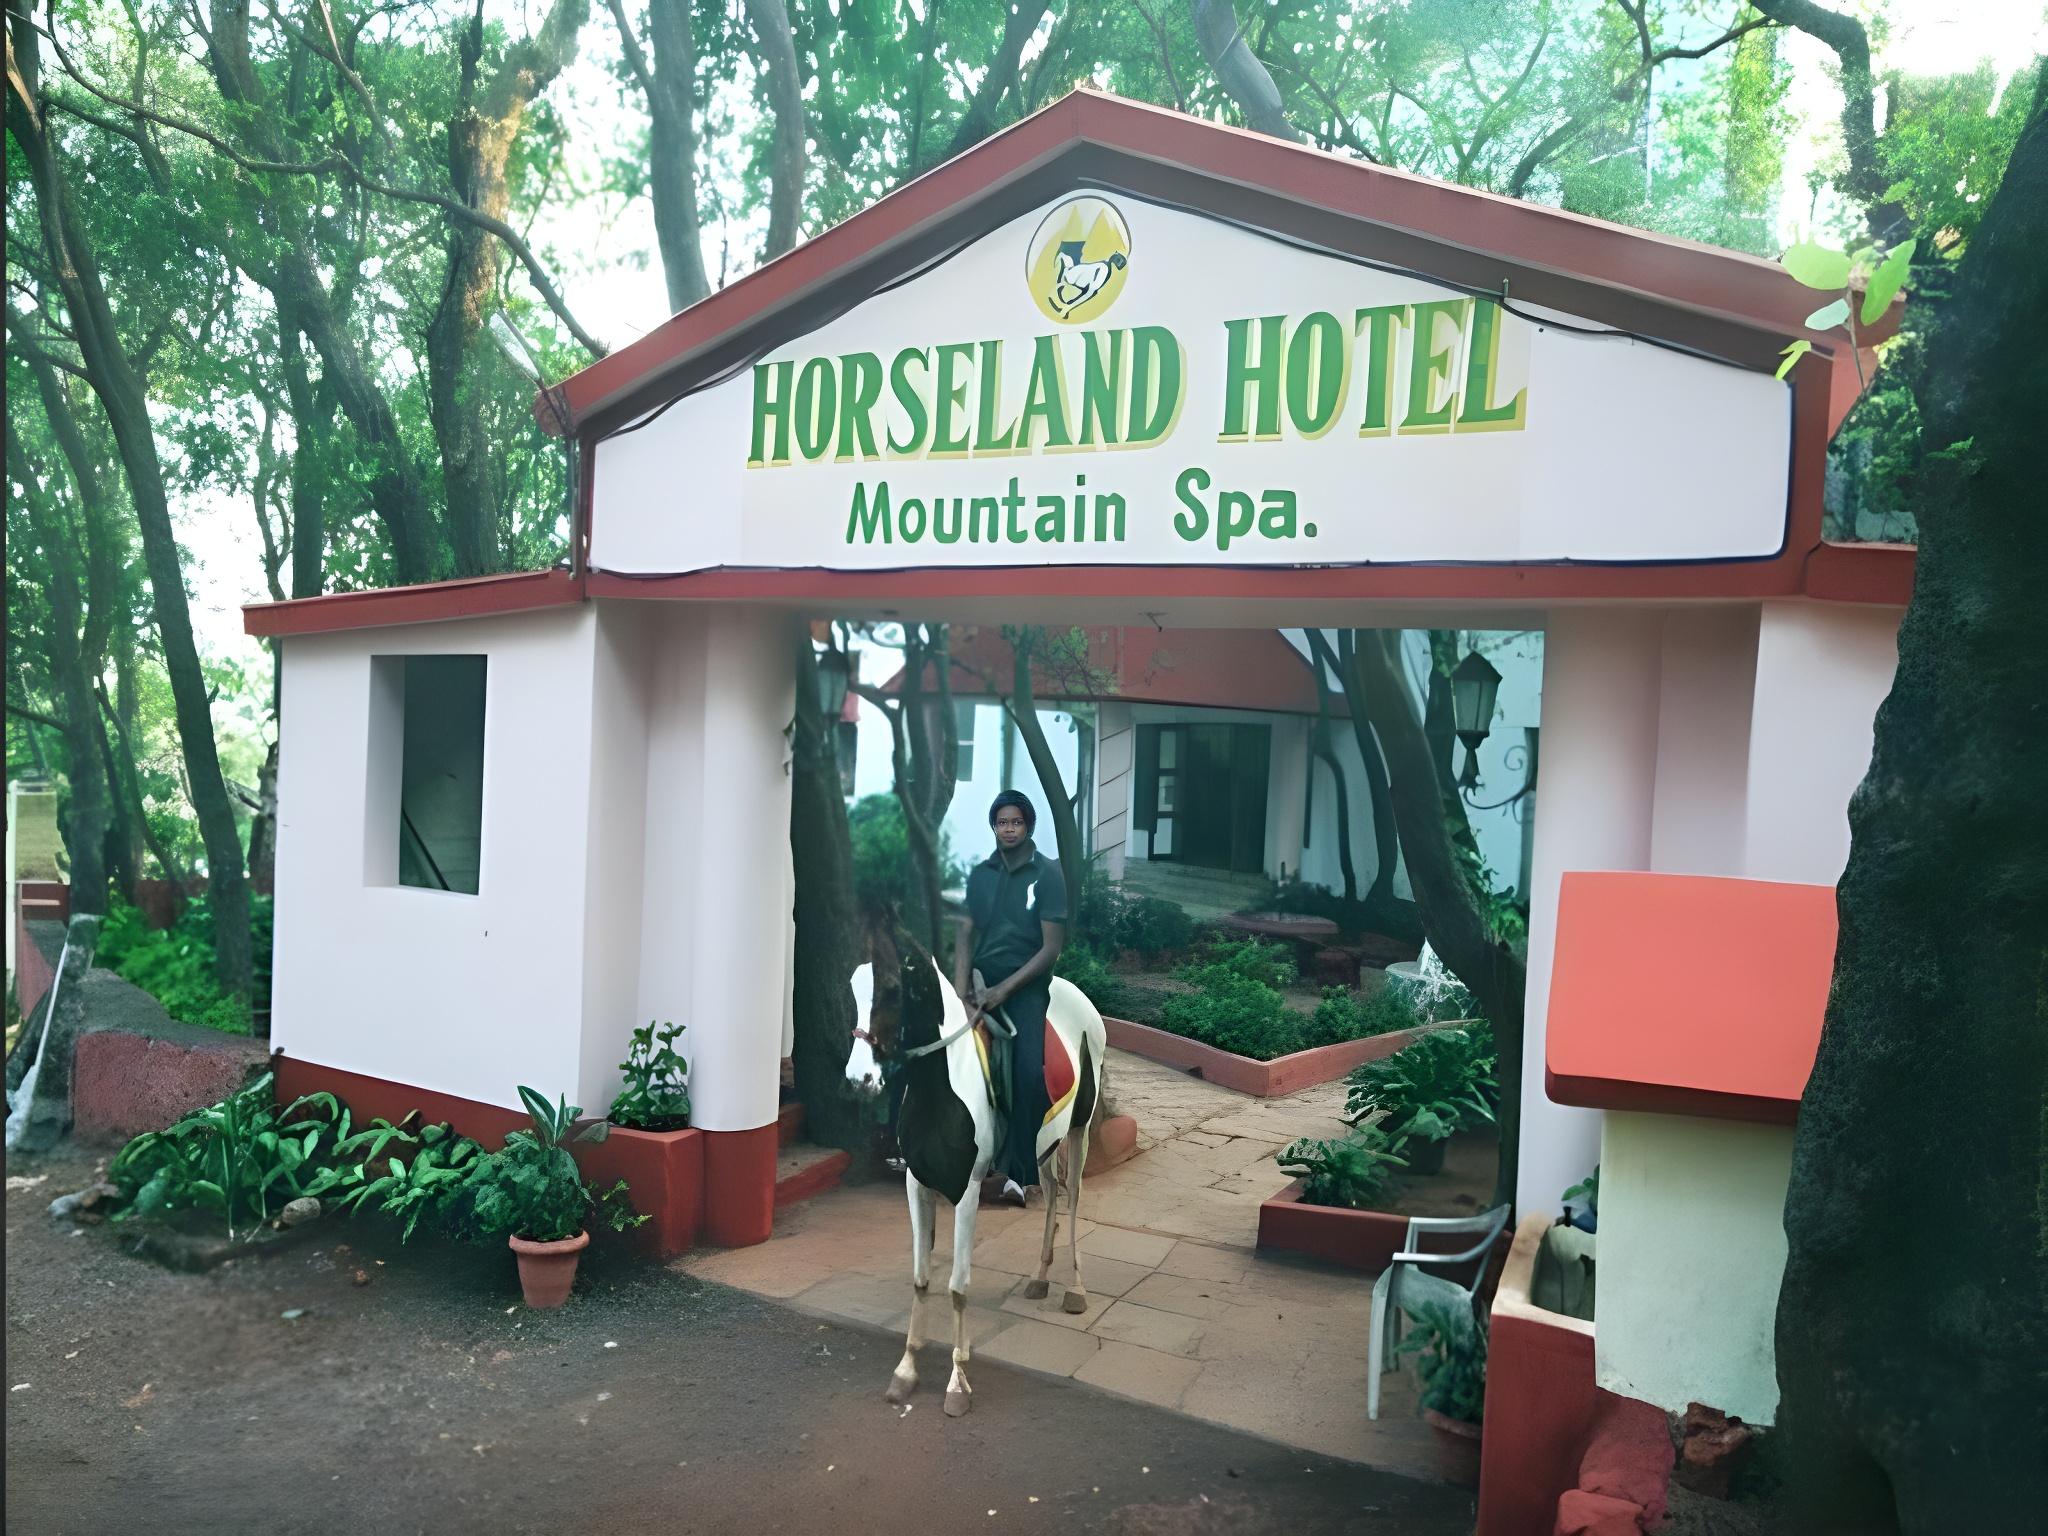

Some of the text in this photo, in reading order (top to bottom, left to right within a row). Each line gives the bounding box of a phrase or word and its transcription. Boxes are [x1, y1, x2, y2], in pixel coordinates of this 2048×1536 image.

[747, 296, 1527, 469] HORSELAND HOTEL
[846, 467, 1318, 551] Mountain Spa.
